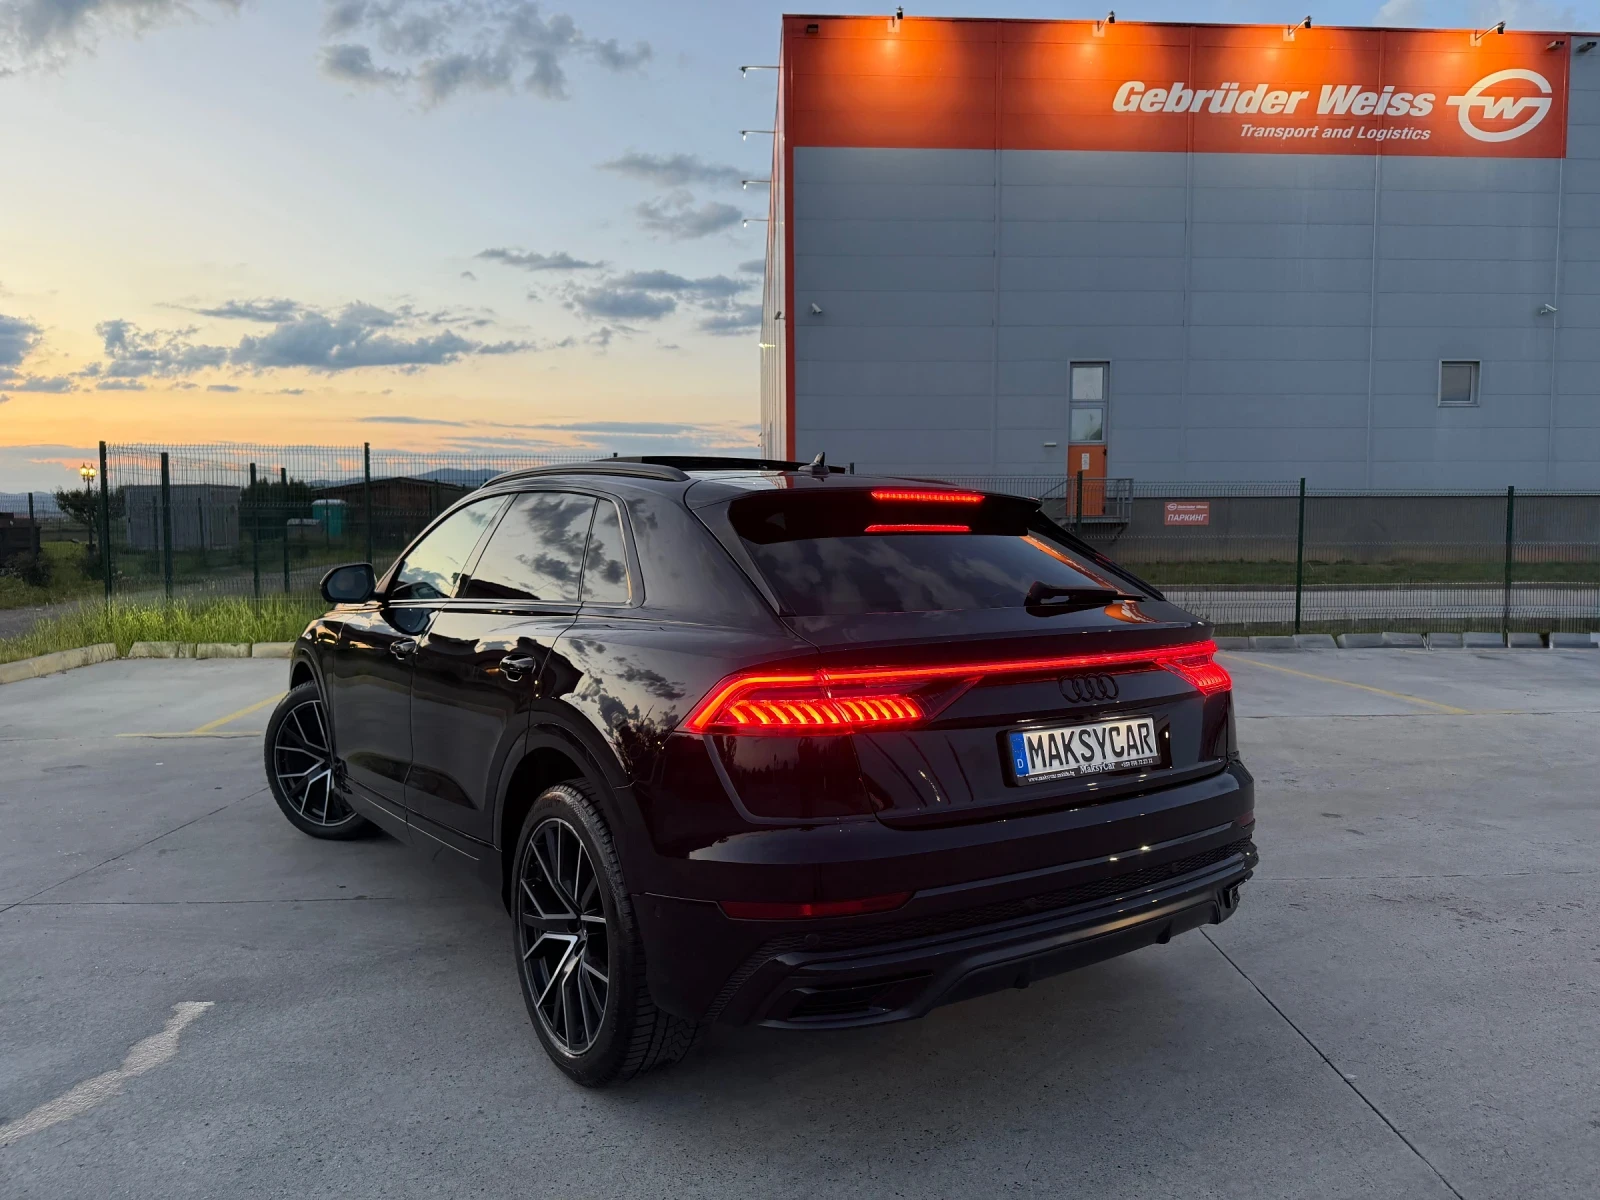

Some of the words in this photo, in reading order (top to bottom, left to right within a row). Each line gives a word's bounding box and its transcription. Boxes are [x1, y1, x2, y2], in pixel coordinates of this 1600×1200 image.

[1112, 80, 1309, 115] Gebrüder
[1316, 84, 1436, 117] Weiss
[1240, 123, 1319, 141] Transport
[1321, 125, 1354, 140] and
[1357, 125, 1432, 143] Logistics
[1168, 513, 1207, 521] ПАРКИНГ
[1026, 722, 1153, 769] MAKSYCAR
[1017, 759, 1024, 769] D
[1080, 761, 1116, 774] MaksyCar
